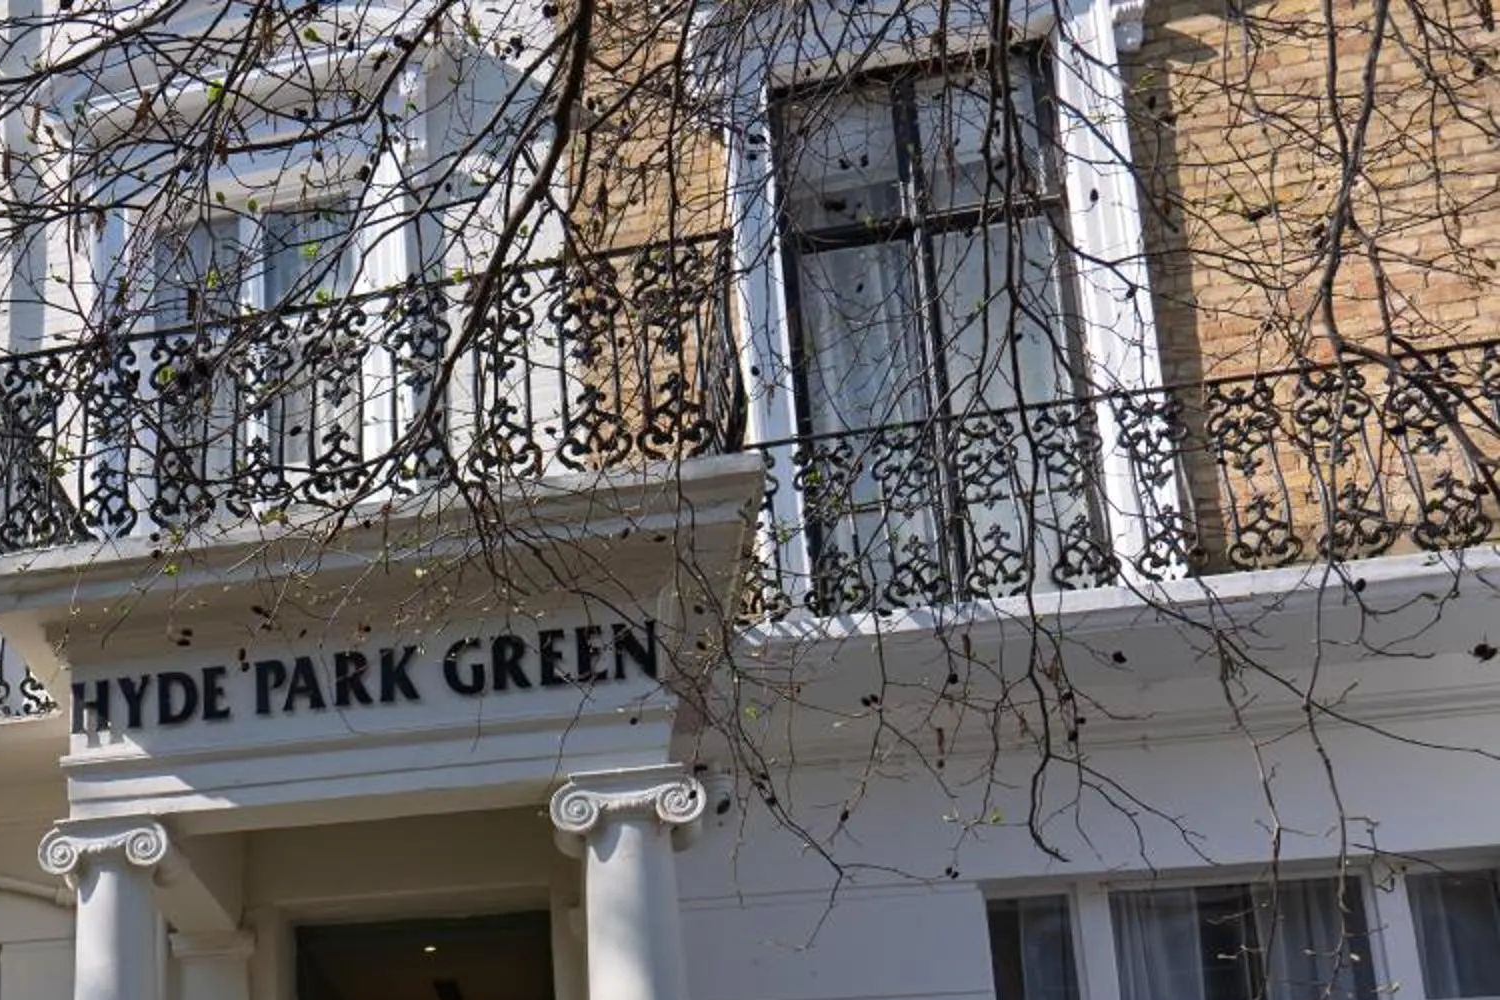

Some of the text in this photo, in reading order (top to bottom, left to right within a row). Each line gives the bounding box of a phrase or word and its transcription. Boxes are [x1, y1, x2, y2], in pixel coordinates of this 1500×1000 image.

[71, 619, 658, 733] HYDE PARK GREEN
